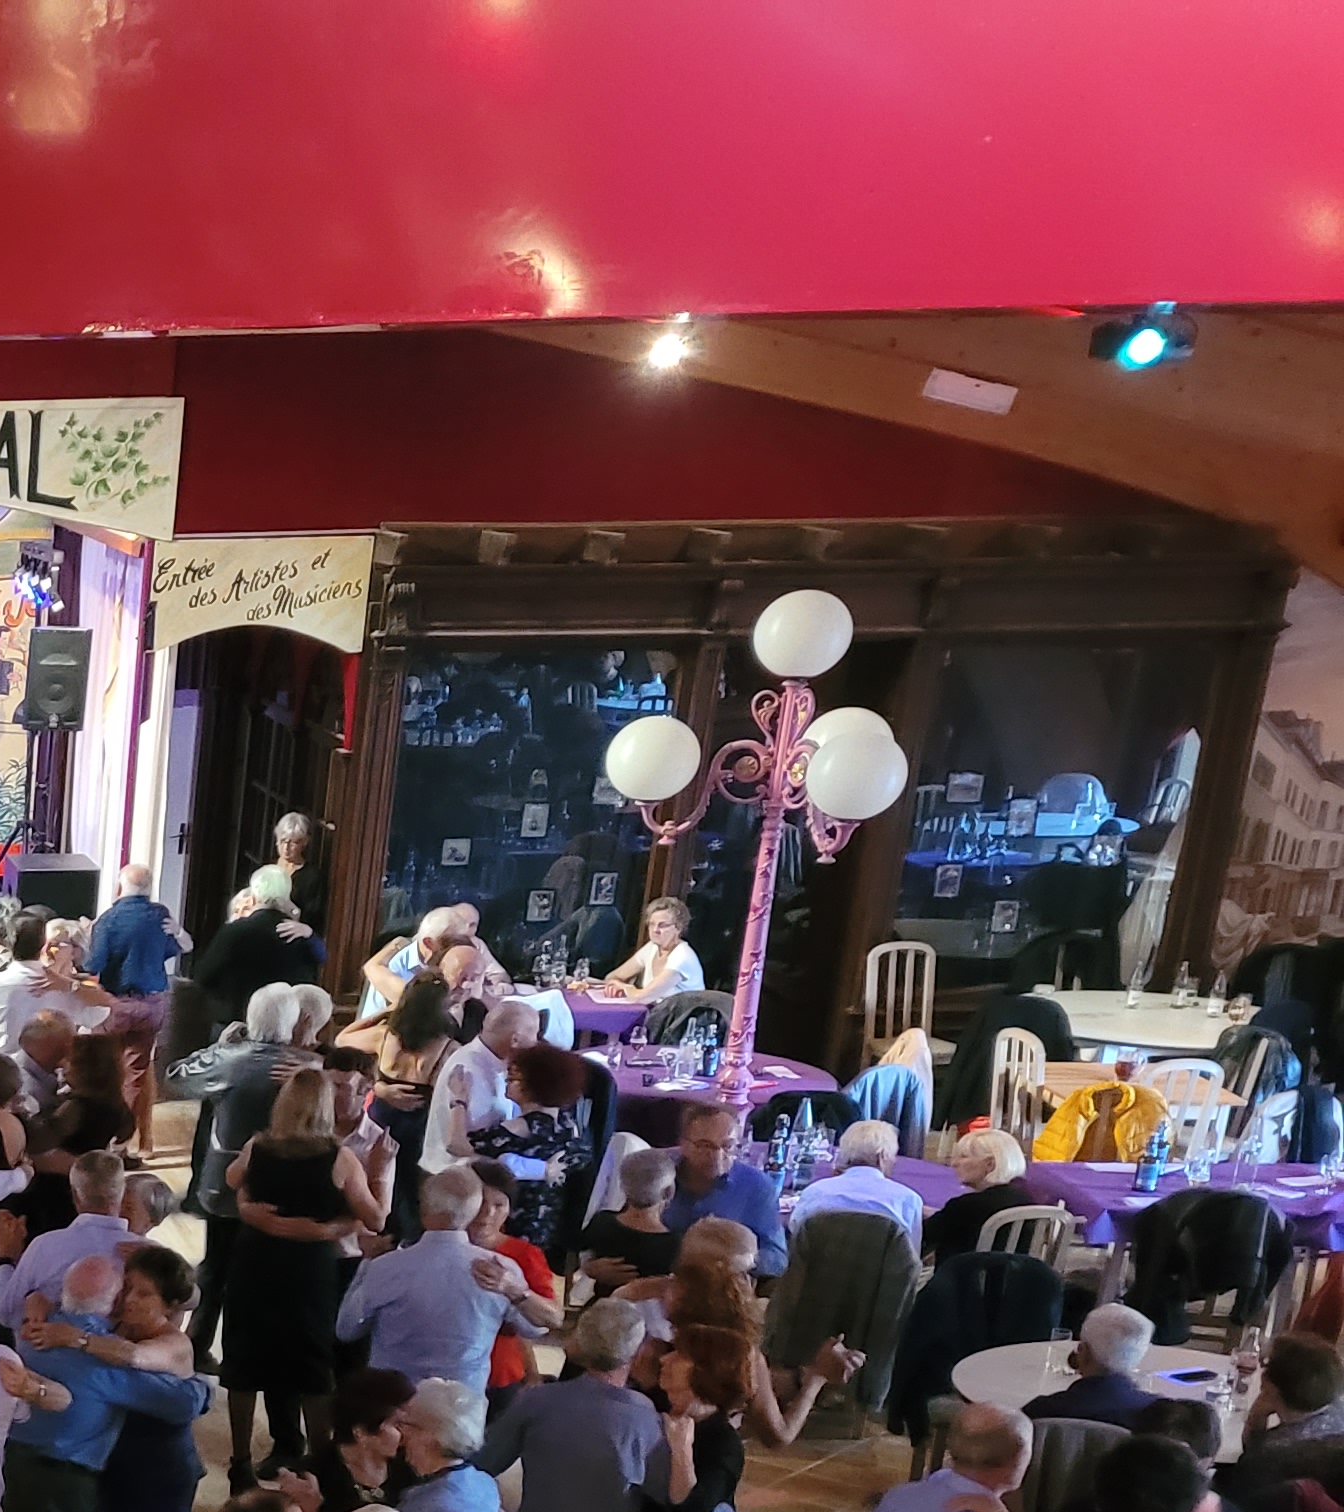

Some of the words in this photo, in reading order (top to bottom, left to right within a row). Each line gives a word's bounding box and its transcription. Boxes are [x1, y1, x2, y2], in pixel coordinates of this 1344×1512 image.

[153, 557, 215, 593] Entrée
[189, 587, 217, 608] des
[222, 560, 298, 604] Artistes
[312, 548, 332, 570] et
[247, 602, 272, 621] des
[272, 579, 362, 618] Musiciens
